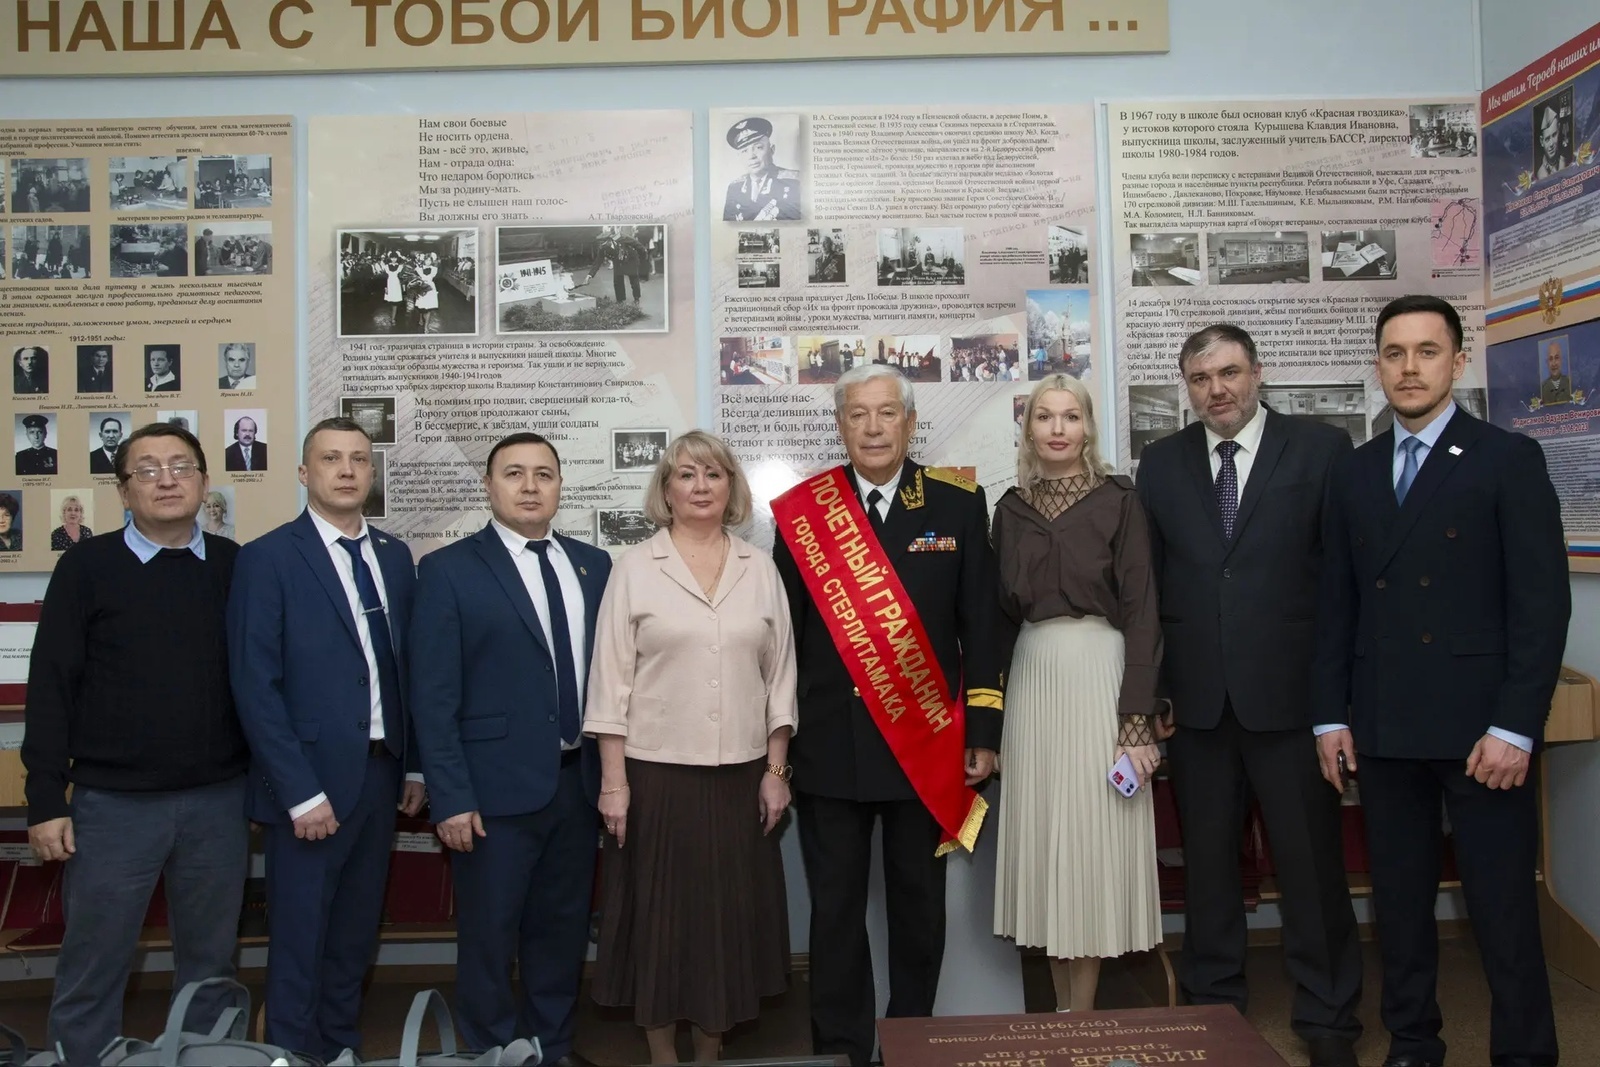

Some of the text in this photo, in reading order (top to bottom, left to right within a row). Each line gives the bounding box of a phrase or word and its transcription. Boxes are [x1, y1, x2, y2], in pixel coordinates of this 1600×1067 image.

[17, 0, 240, 52] НАША
[268, 0, 314, 49] С
[1486, 94, 1501, 112] Мы
[1502, 83, 1526, 103] чтим
[1527, 58, 1558, 90] Героев
[1558, 46, 1588, 72] наших
[1119, 111, 1127, 120] В
[1131, 110, 1152, 120] 1967
[1155, 113, 1177, 122] году
[1220, 109, 1240, 119] был
[1284, 108, 1307, 120] клуб
[1309, 108, 1354, 120] «Красная
[419, 118, 440, 128] Нам
[469, 117, 506, 127] боевые
[1123, 126, 1129, 135] у
[1172, 125, 1215, 134] которого
[1254, 121, 1304, 133] Курышева
[1306, 120, 1346, 131] Клавдия
[419, 131, 433, 141] Не
[1122, 138, 1180, 148] выпускница
[1221, 134, 1285, 147] заслуженный
[1288, 136, 1326, 146] учитель
[1368, 135, 1412, 145] директор
[418, 145, 440, 154] Вам
[450, 144, 466, 154] всё
[1158, 148, 1206, 158] 1980-1984
[418, 158, 440, 168] Нам
[450, 160, 485, 170] отрада
[487, 160, 514, 168] одна:
[419, 169, 534, 182] Что недаром боролись
[419, 185, 438, 194] Мы
[419, 197, 450, 209] Пусть
[419, 211, 434, 221] Вы
[437, 213, 479, 222] должны
[606, 212, 654, 222] Твардовский
[723, 294, 762, 303] Ежегодно
[845, 293, 865, 301] День
[69, 333, 102, 341] 1912-1951
[414, 397, 431, 405] Мы
[473, 398, 491, 406] про
[529, 394, 588, 406] свершенный
[721, 393, 742, 403] Всё
[414, 408, 448, 419] Дорогу
[480, 409, 538, 418] продолжают
[721, 407, 818, 419] Всегда деливших
[531, 421, 557, 431] ушли
[559, 420, 598, 429] солдаты
[773, 420, 800, 432] боль
[413, 433, 442, 444] Герои
[474, 434, 506, 443] отгрем
[776, 438, 821, 449] поверке
[809, 473, 953, 734] ПОЧЕТНЫЙ ГРАЖДАНИН
[792, 515, 906, 724] города СТЕРЛИТАМАКА
